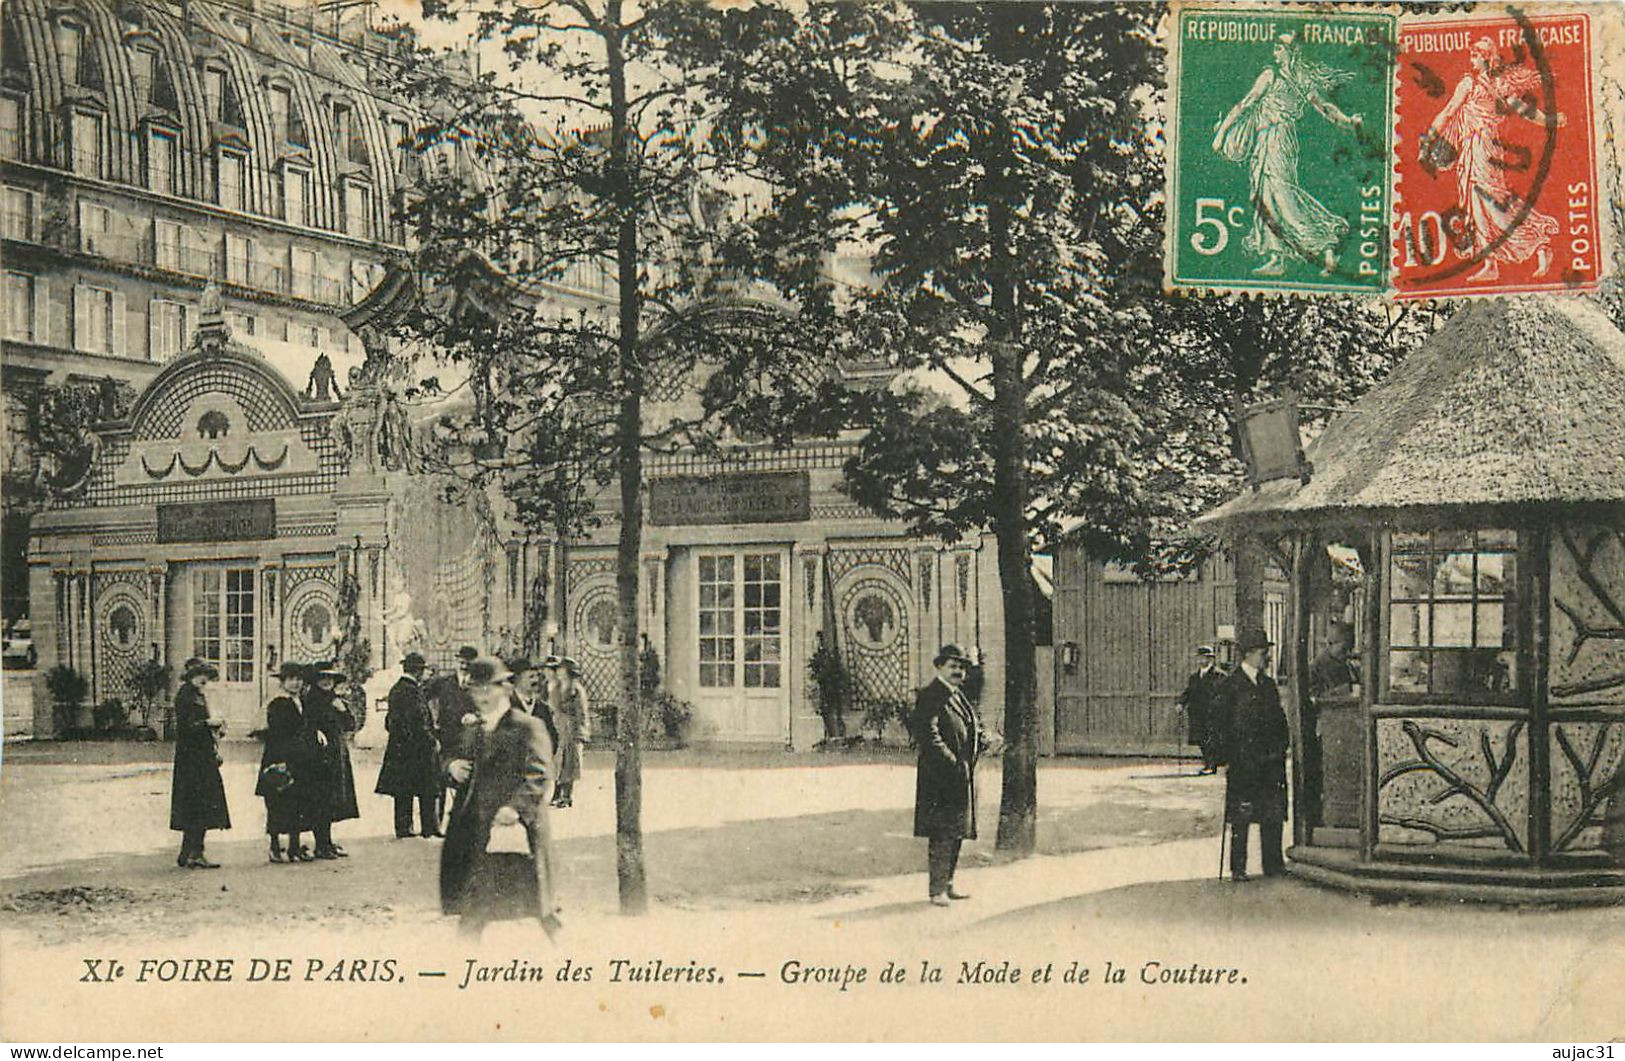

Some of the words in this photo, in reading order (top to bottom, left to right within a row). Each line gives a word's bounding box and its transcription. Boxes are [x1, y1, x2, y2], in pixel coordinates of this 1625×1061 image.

[1303, 23, 1385, 47] FRANÇA
[1498, 24, 1581, 49] FRAÇAISE
[1359, 185, 1381, 275] POSTES
[1568, 182, 1591, 270] POSTES
